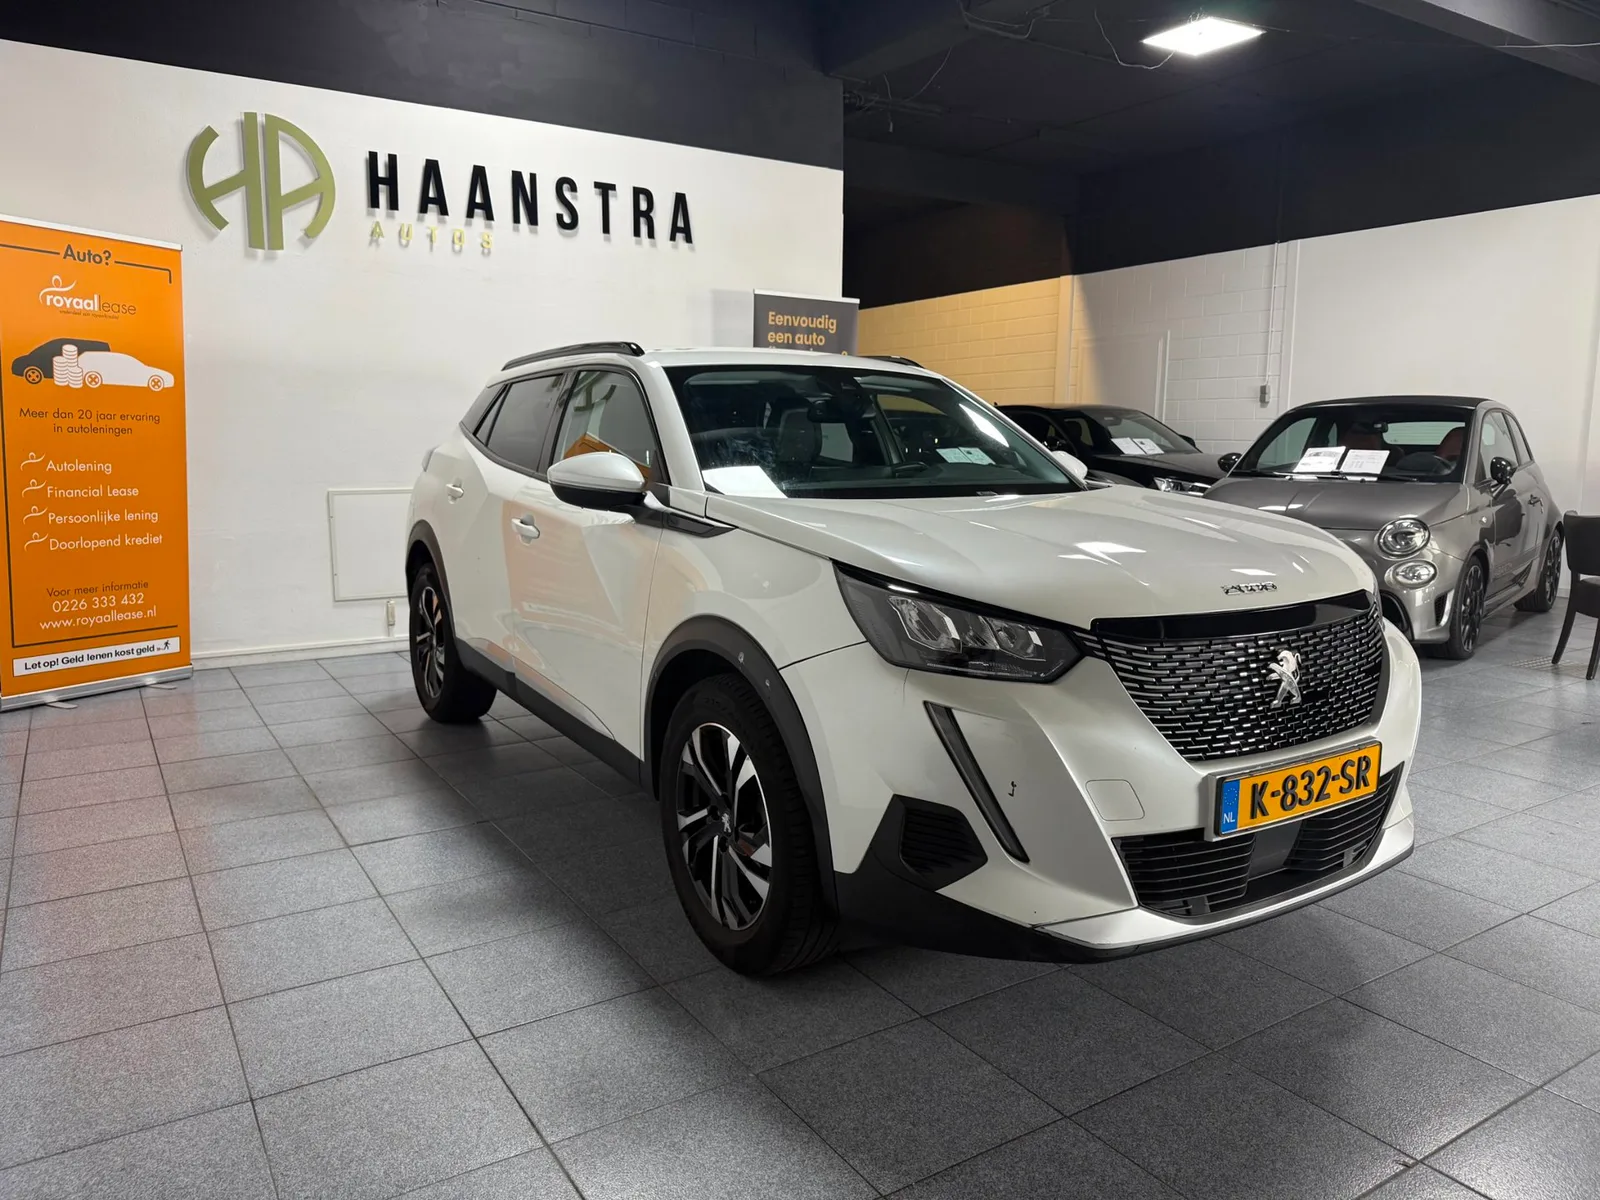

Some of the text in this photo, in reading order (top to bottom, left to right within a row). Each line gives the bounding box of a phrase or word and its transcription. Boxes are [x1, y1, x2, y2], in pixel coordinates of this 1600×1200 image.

[367, 150, 694, 244] HAANSTRA
[369, 220, 494, 250] AUTOS
[62, 244, 113, 266] Auto?
[768, 311, 837, 334] Eenvoudig
[768, 332, 826, 346] een auto
[19, 407, 161, 424] Meer dan 20 jaar ervaring
[53, 423, 133, 437] in autoleningen
[46, 460, 112, 475] Autolening
[47, 485, 139, 498] Financial Lease
[48, 509, 159, 526] Persoonlijke lening
[49, 534, 163, 552] Doorlopend krediet
[46, 581, 149, 598] Voor meer informatie
[52, 592, 145, 613] 0226 333 432
[39, 605, 157, 630] www.royaallease.nl
[24, 644, 156, 671] Let op! Geld lenen kost geld
[1250, 755, 1371, 820] K-832-SR
[1223, 811, 1236, 824] NL
